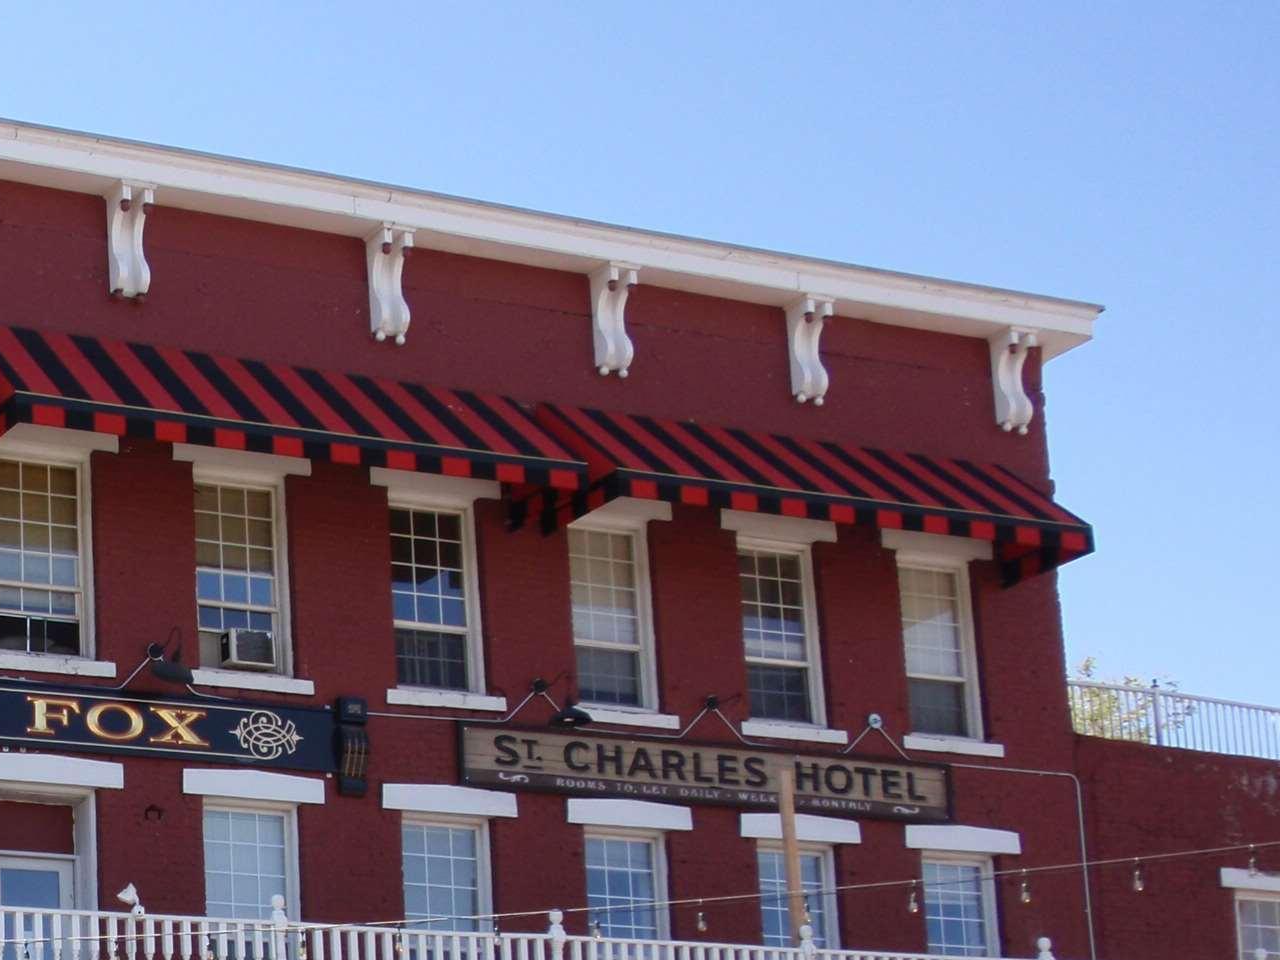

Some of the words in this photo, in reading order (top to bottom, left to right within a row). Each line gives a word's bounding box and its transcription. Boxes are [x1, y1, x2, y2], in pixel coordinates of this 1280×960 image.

[27, 694, 210, 747] FOX
[556, 778, 606, 791] ROOMS
[643, 785, 668, 795] LET
[680, 788, 720, 799] DAILY
[738, 792, 778, 803] WEEK
[811, 799, 872, 812] MONTHLY
[563, 741, 769, 788] CHARLES
[793, 761, 927, 801] HOTEL
